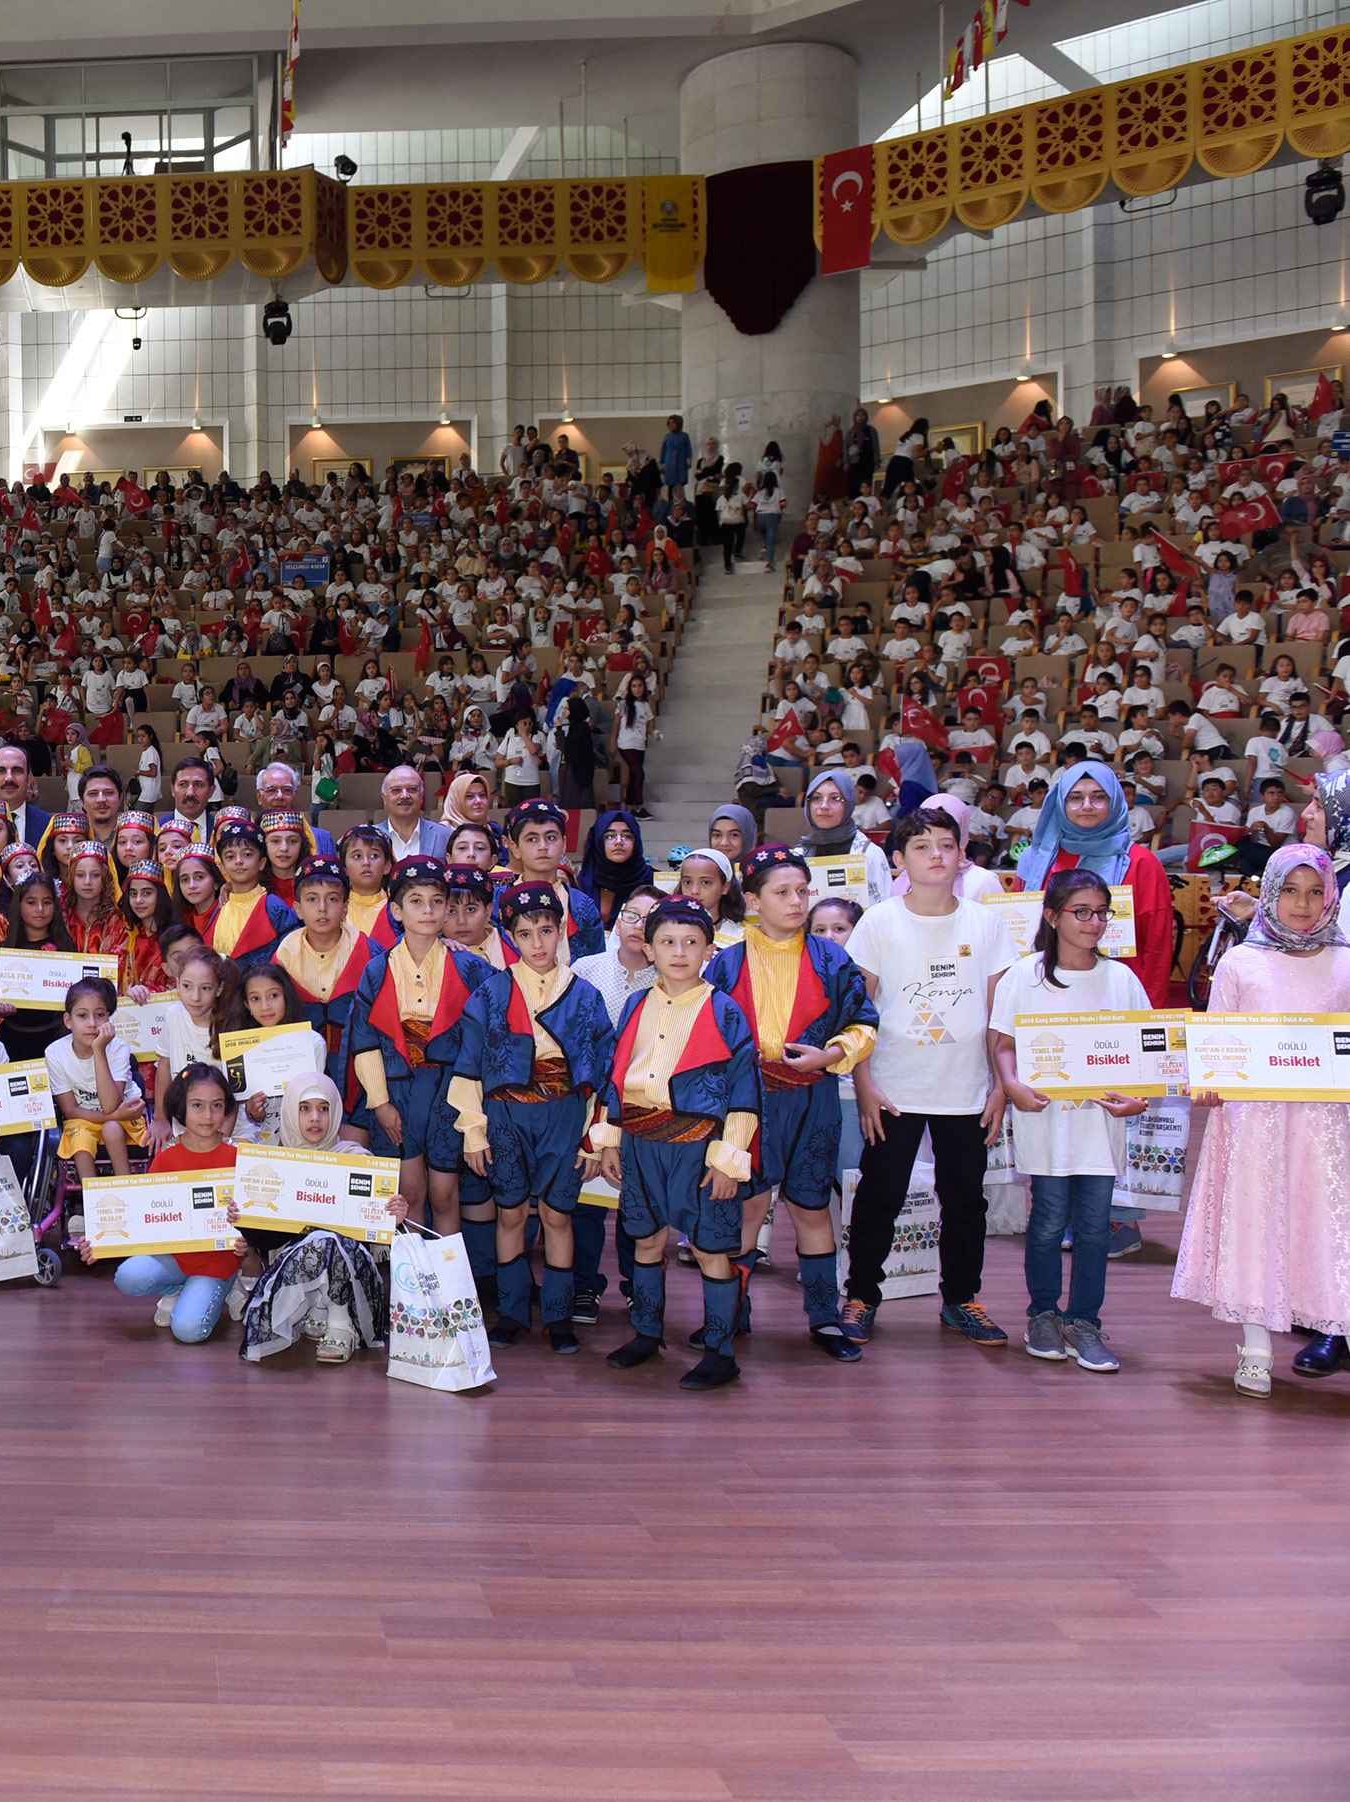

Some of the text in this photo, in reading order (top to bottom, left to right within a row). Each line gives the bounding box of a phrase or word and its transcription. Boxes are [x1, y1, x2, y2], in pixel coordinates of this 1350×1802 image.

[903, 982, 974, 1006] Konya
[1094, 1040, 1119, 1049] ÖDÜLÜ
[1278, 1042, 1307, 1050] ÖDÜLÜ
[1087, 1054, 1130, 1065] Bisiklet
[1269, 1056, 1320, 1066] Bisiklet
[305, 1179, 328, 1188] ÖDÜLÜ
[296, 1191, 336, 1204] Bisiklet
[151, 1200, 173, 1209] ÖDÜLÜ
[145, 1212, 182, 1224] Bisiklet
